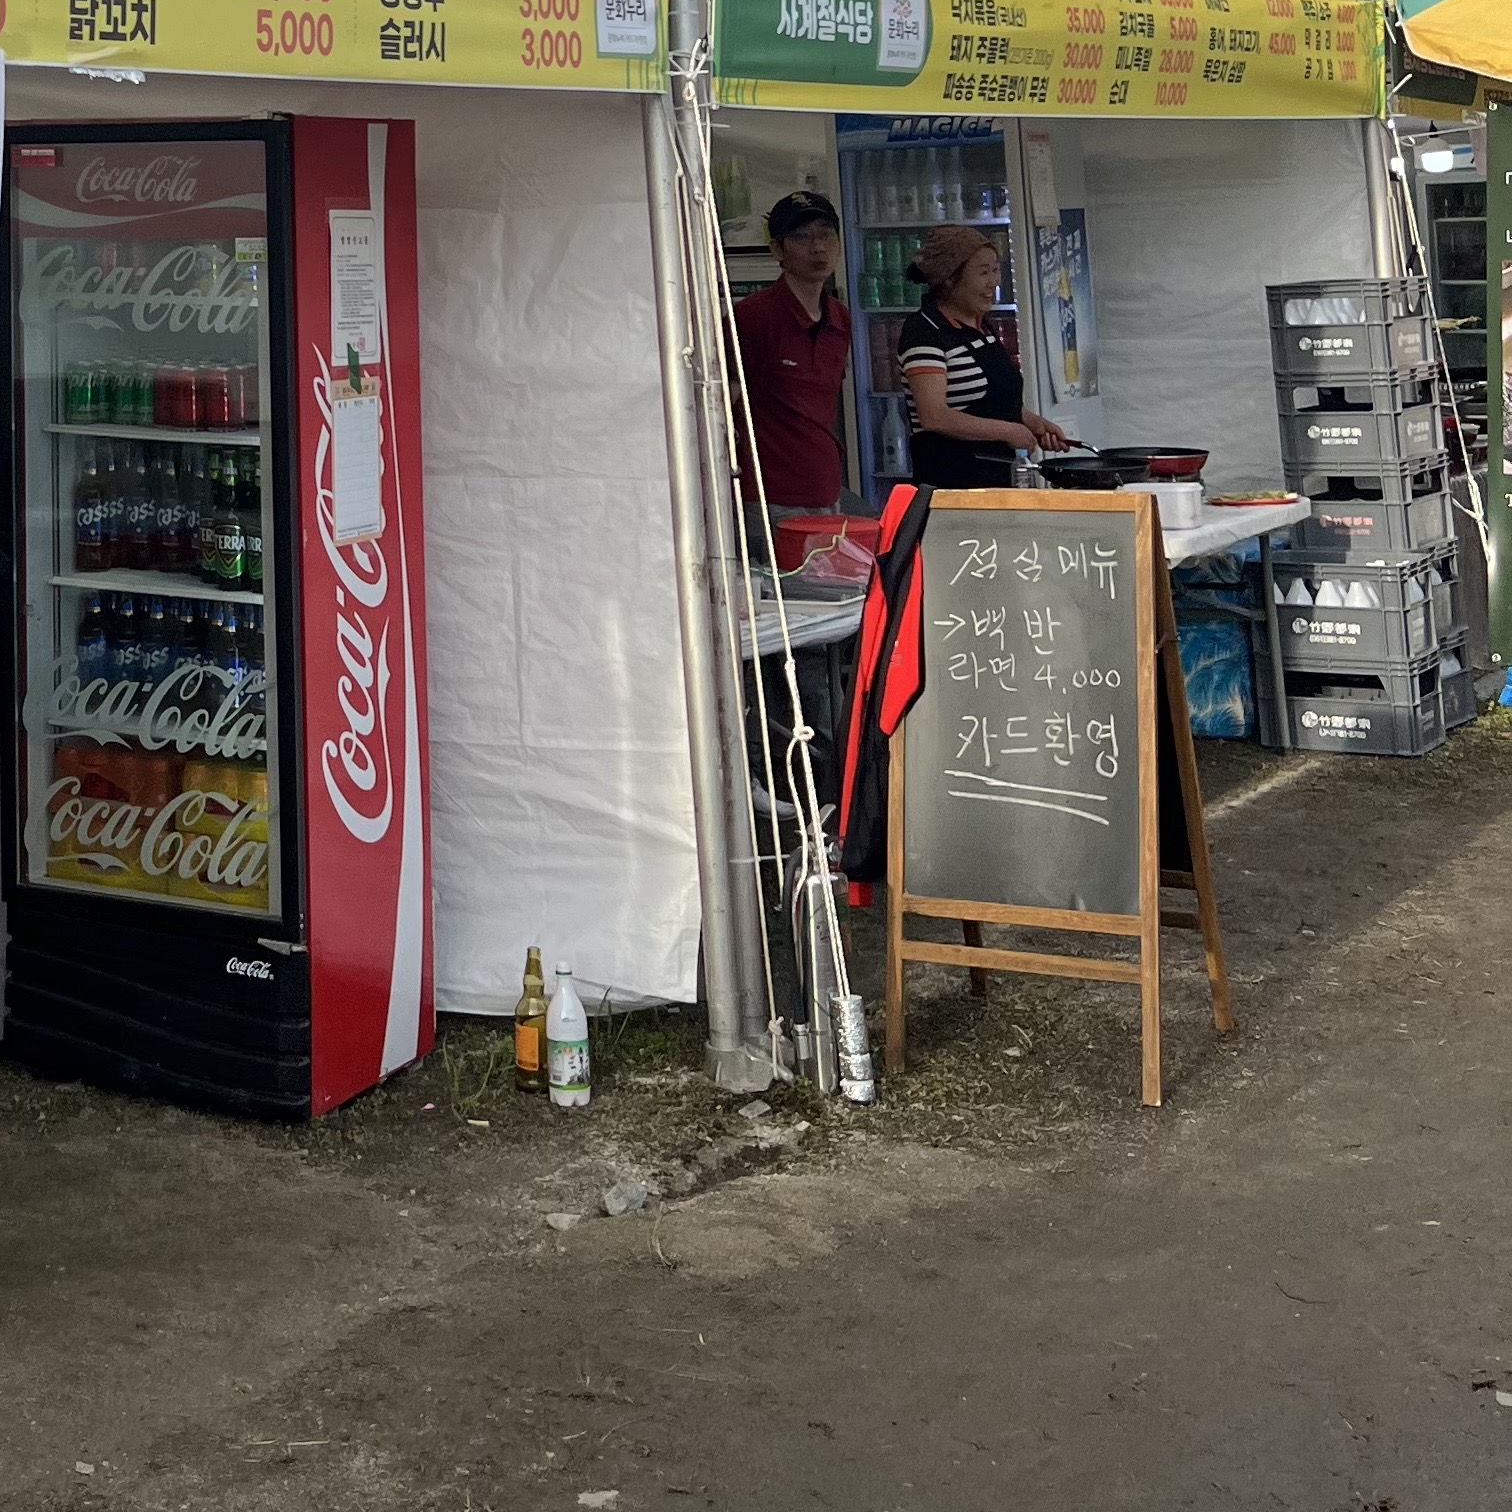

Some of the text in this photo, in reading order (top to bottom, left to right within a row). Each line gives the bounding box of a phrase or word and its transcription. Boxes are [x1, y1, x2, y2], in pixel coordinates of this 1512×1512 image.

[255, 9, 334, 58] 5,000
[378, 17, 582, 69] 슬러시 3,000
[1066, 7, 1106, 34] 35,000
[1170, 16, 1198, 41] 5,000
[1063, 42, 1103, 70] 30,000
[1056, 78, 1097, 105] 30,000
[1109, 79, 1129, 105] 순대
[76, 155, 202, 203] Coca-Cola
[20, 245, 260, 334] Coca-Cola
[1058, 542, 1120, 600] 메뉴
[948, 651, 1018, 693] 라면
[23, 653, 267, 759] Coca-Cola
[955, 711, 1121, 779] 카드환영
[24, 776, 268, 886] Coca-Cola
[226, 956, 271, 979] Coca-Cola
